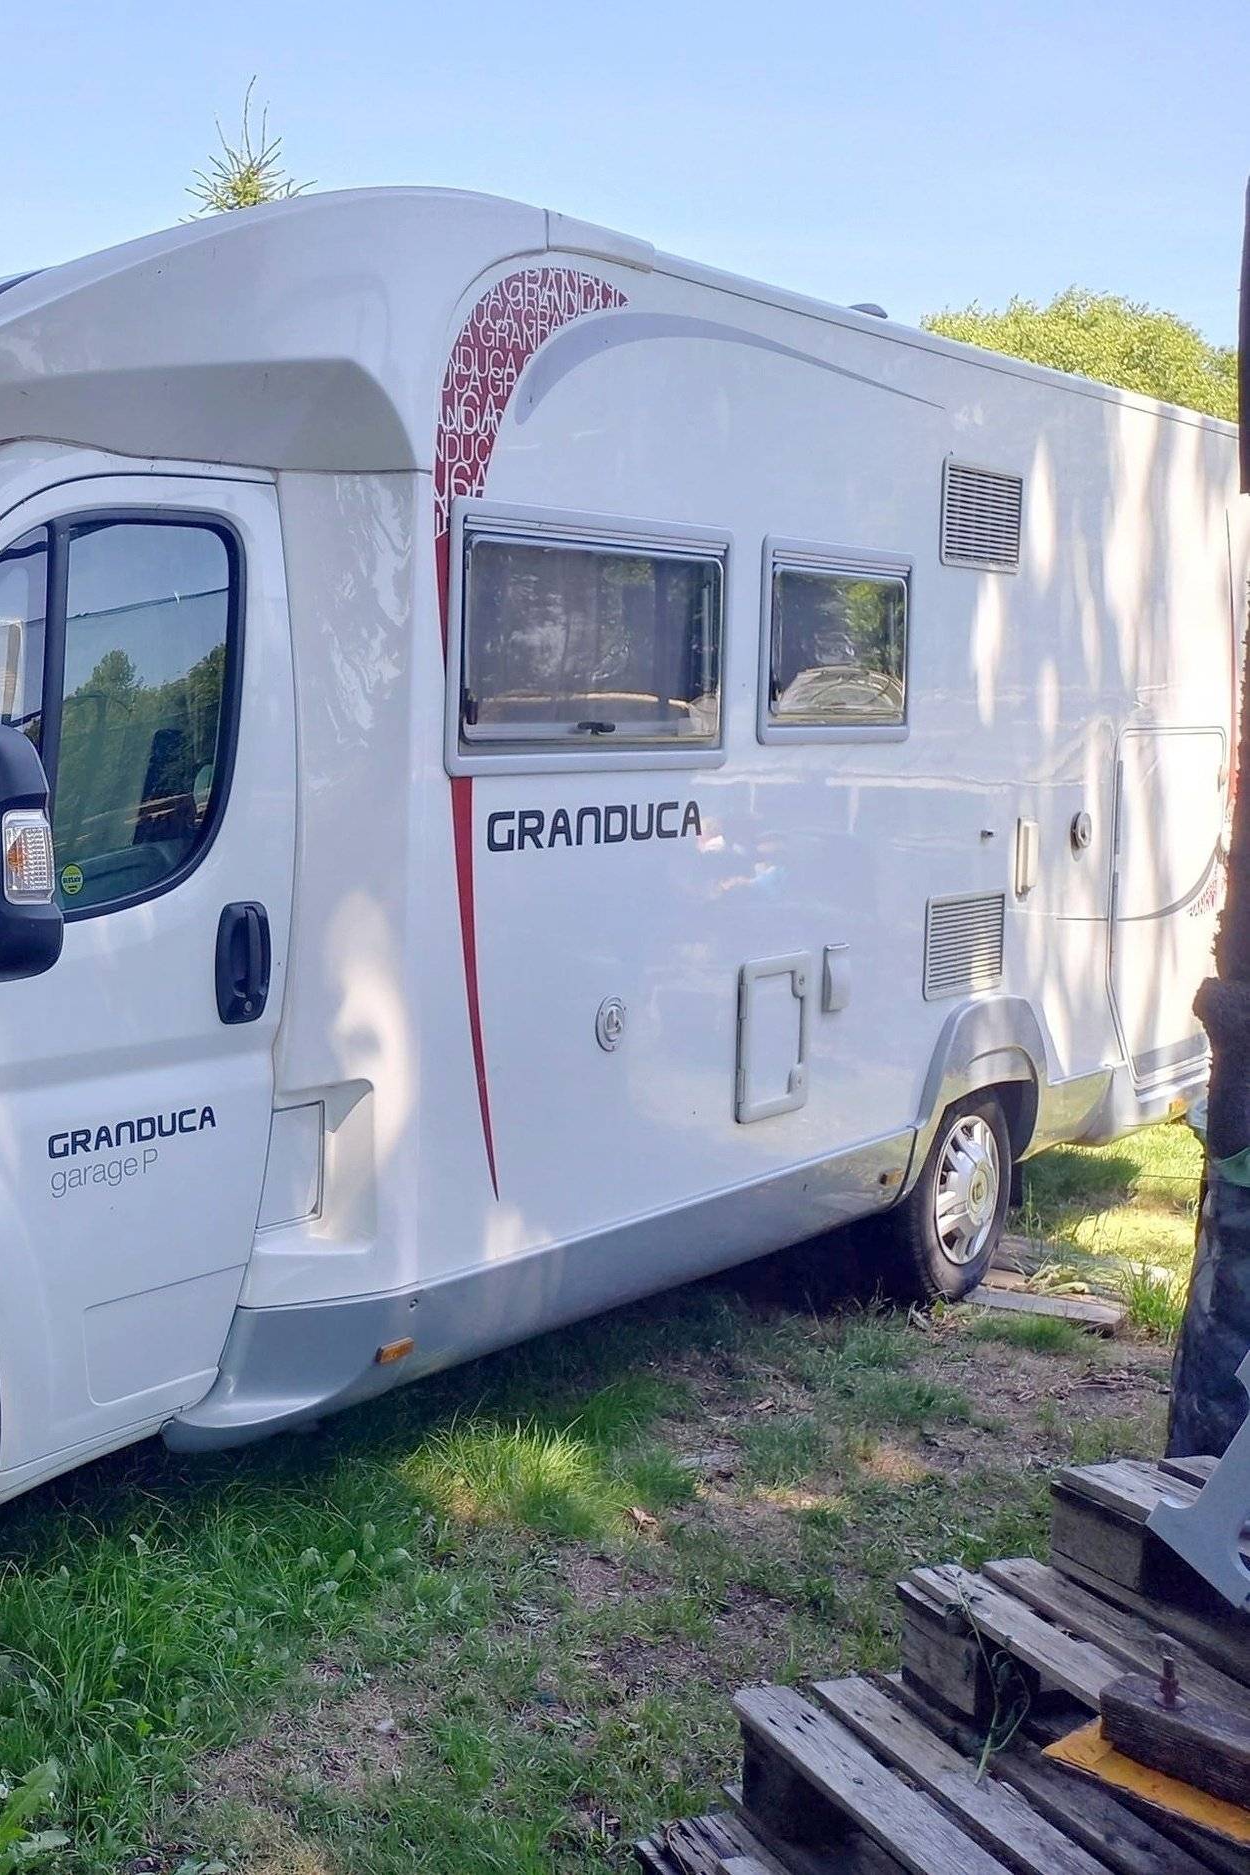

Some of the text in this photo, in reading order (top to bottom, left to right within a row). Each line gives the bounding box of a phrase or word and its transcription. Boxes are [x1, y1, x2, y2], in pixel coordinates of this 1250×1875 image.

[487, 800, 702, 852] GRANDUCA
[48, 1106, 216, 1159] GRANDUCA
[51, 1148, 159, 1199] garage P
